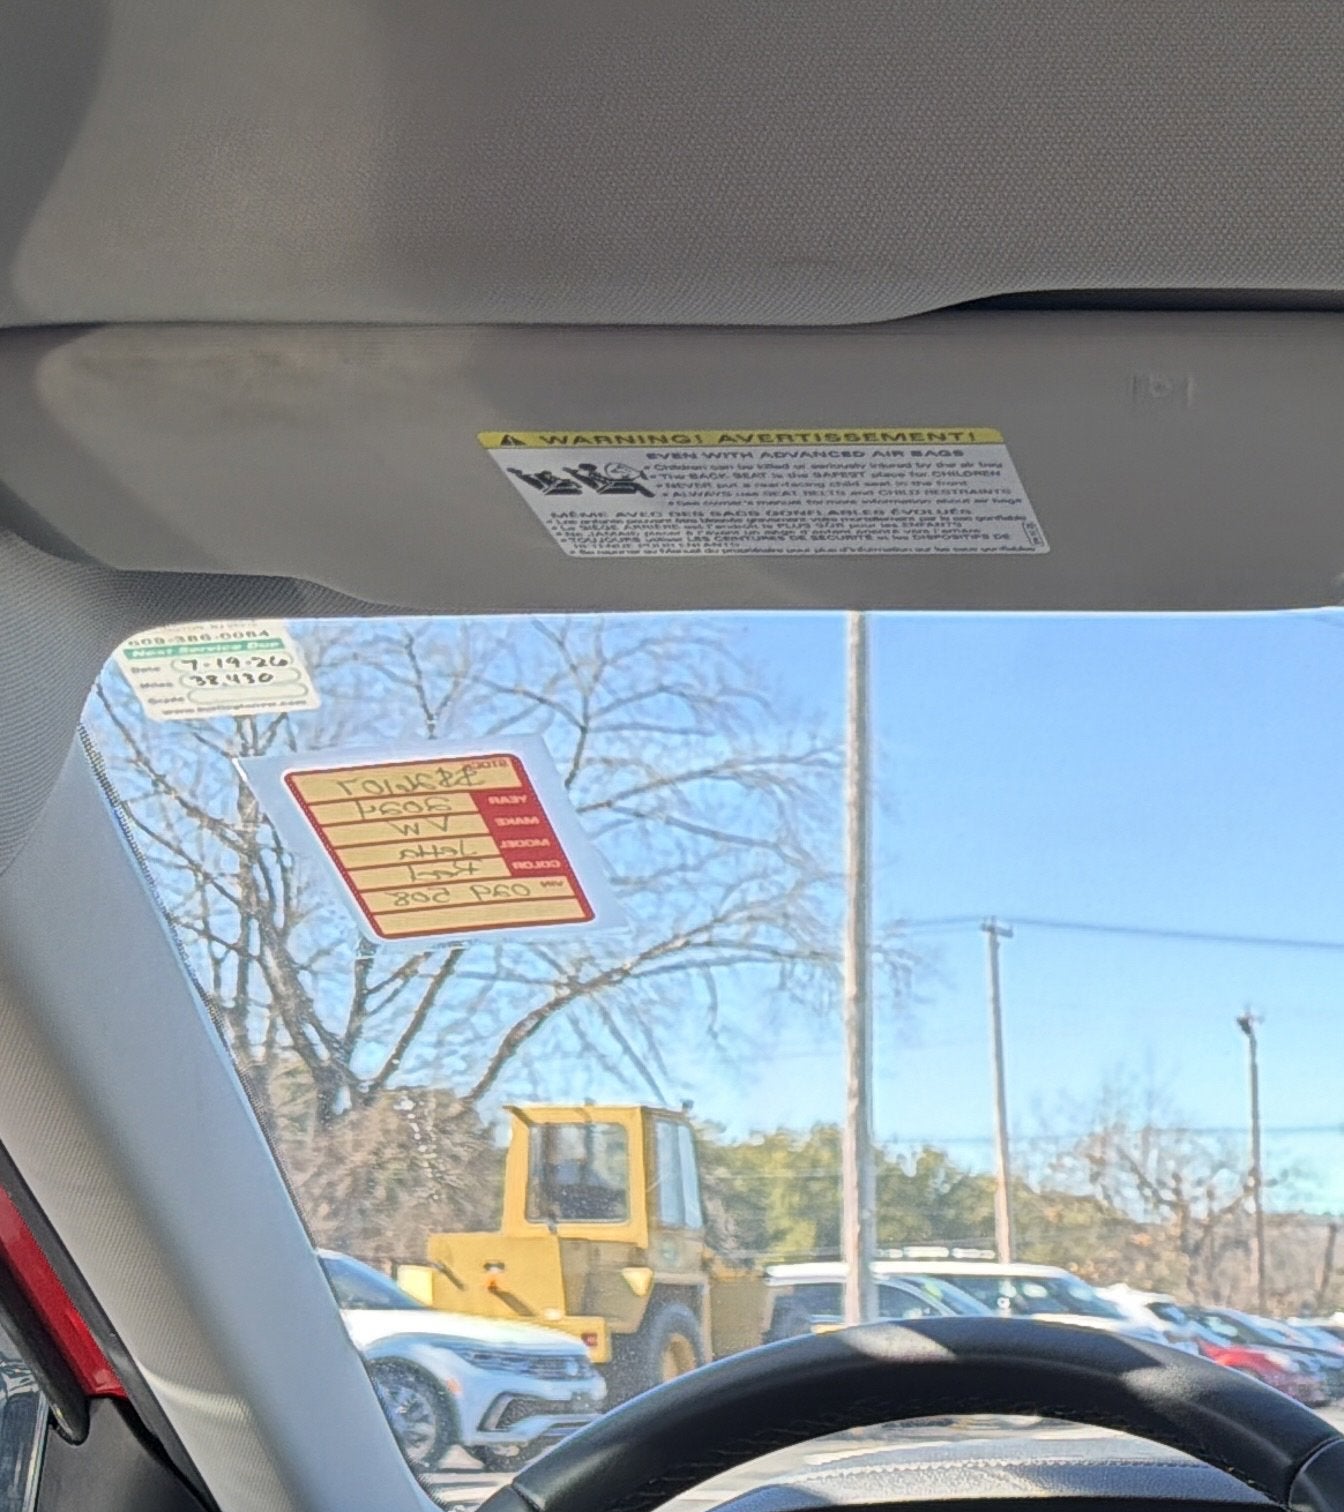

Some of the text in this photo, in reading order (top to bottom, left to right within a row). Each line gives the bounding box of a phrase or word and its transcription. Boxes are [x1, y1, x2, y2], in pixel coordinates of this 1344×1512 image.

[538, 431, 977, 446] WARNING! AVERTISSEMENT!
[646, 452, 698, 460] EVEN
[701, 451, 753, 459] WITH
[760, 450, 865, 459] ADVANCED
[872, 450, 905, 458] AIR
